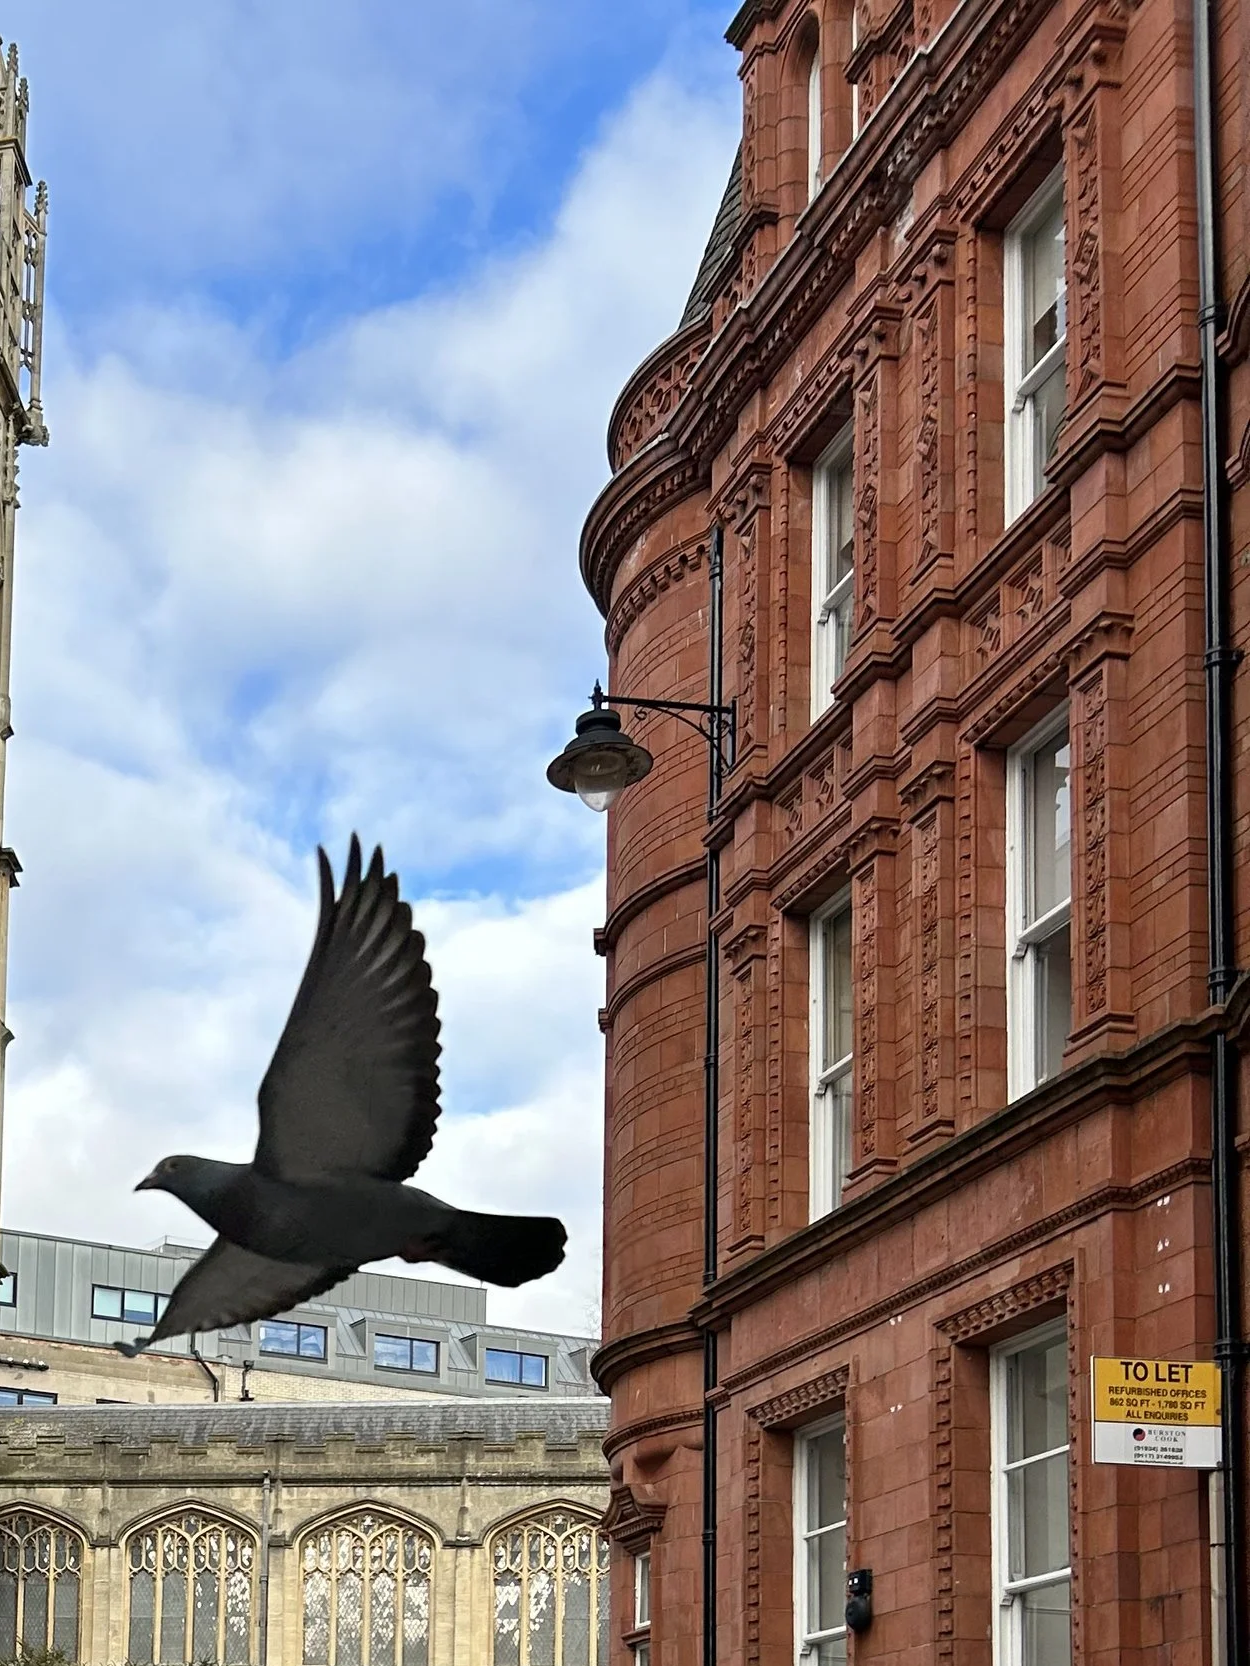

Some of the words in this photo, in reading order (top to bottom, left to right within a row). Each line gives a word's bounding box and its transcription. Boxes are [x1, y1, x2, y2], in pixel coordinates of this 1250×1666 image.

[1120, 1361, 1148, 1381] TO
[1155, 1363, 1193, 1383] LET
[1108, 1386, 1168, 1397] REFURBISHED
[1170, 1389, 1207, 1398] OFFICES
[1126, 1398, 1138, 1407] SQ
[1140, 1399, 1150, 1408] FT
[1180, 1401, 1192, 1410] SQ
[1194, 1401, 1206, 1410] FT
[1126, 1410, 1142, 1419] ALL
[1144, 1411, 1189, 1421] ENQUIRIES
